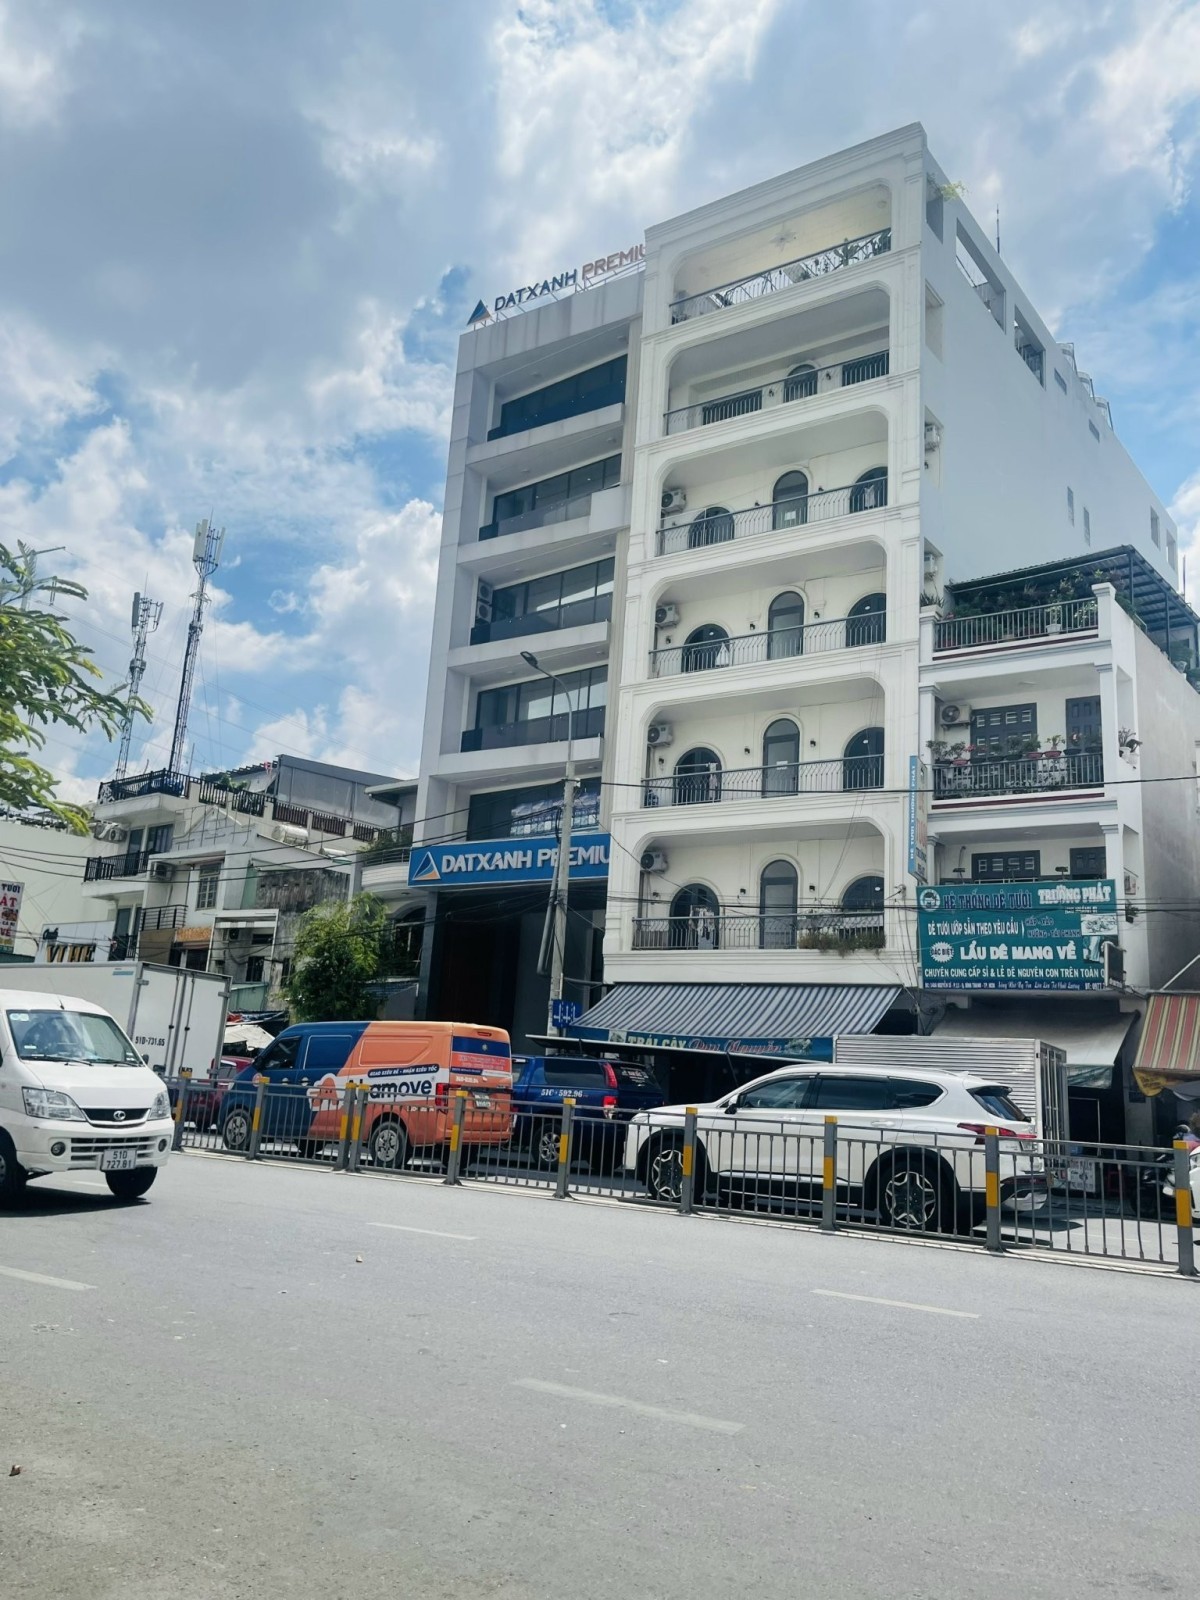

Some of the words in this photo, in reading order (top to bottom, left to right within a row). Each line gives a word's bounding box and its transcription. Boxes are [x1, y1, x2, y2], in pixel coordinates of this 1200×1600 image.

[494, 269, 577, 311] DATXANH
[582, 244, 645, 280] PREMIU
[441, 850, 531, 873] DATXANH
[537, 845, 610, 868] PREMIU
[0, 893, 17, 907] ÁT
[1082, 882, 1111, 903] PHÁT
[976, 922, 992, 934] THEO
[993, 919, 1005, 934] YÊU
[990, 943, 1008, 960] DÊ
[1012, 946, 1053, 960] MANG
[1056, 940, 1076, 960] VỀ
[925, 966, 949, 977] CHUYÊN
[950, 968, 967, 977] CUNG
[968, 965, 980, 977] CẤP
[990, 968, 995, 977] &
[1007, 966, 1015, 977] DÊ
[1018, 966, 1044, 977] NGUYÊN
[1045, 968, 1059, 977] CON
[1060, 966, 1078, 978] TRÊN
[1080, 966, 1098, 978] TOÀN
[662, 1037, 686, 1048] CÂY
[347, 1080, 432, 1099] amove
